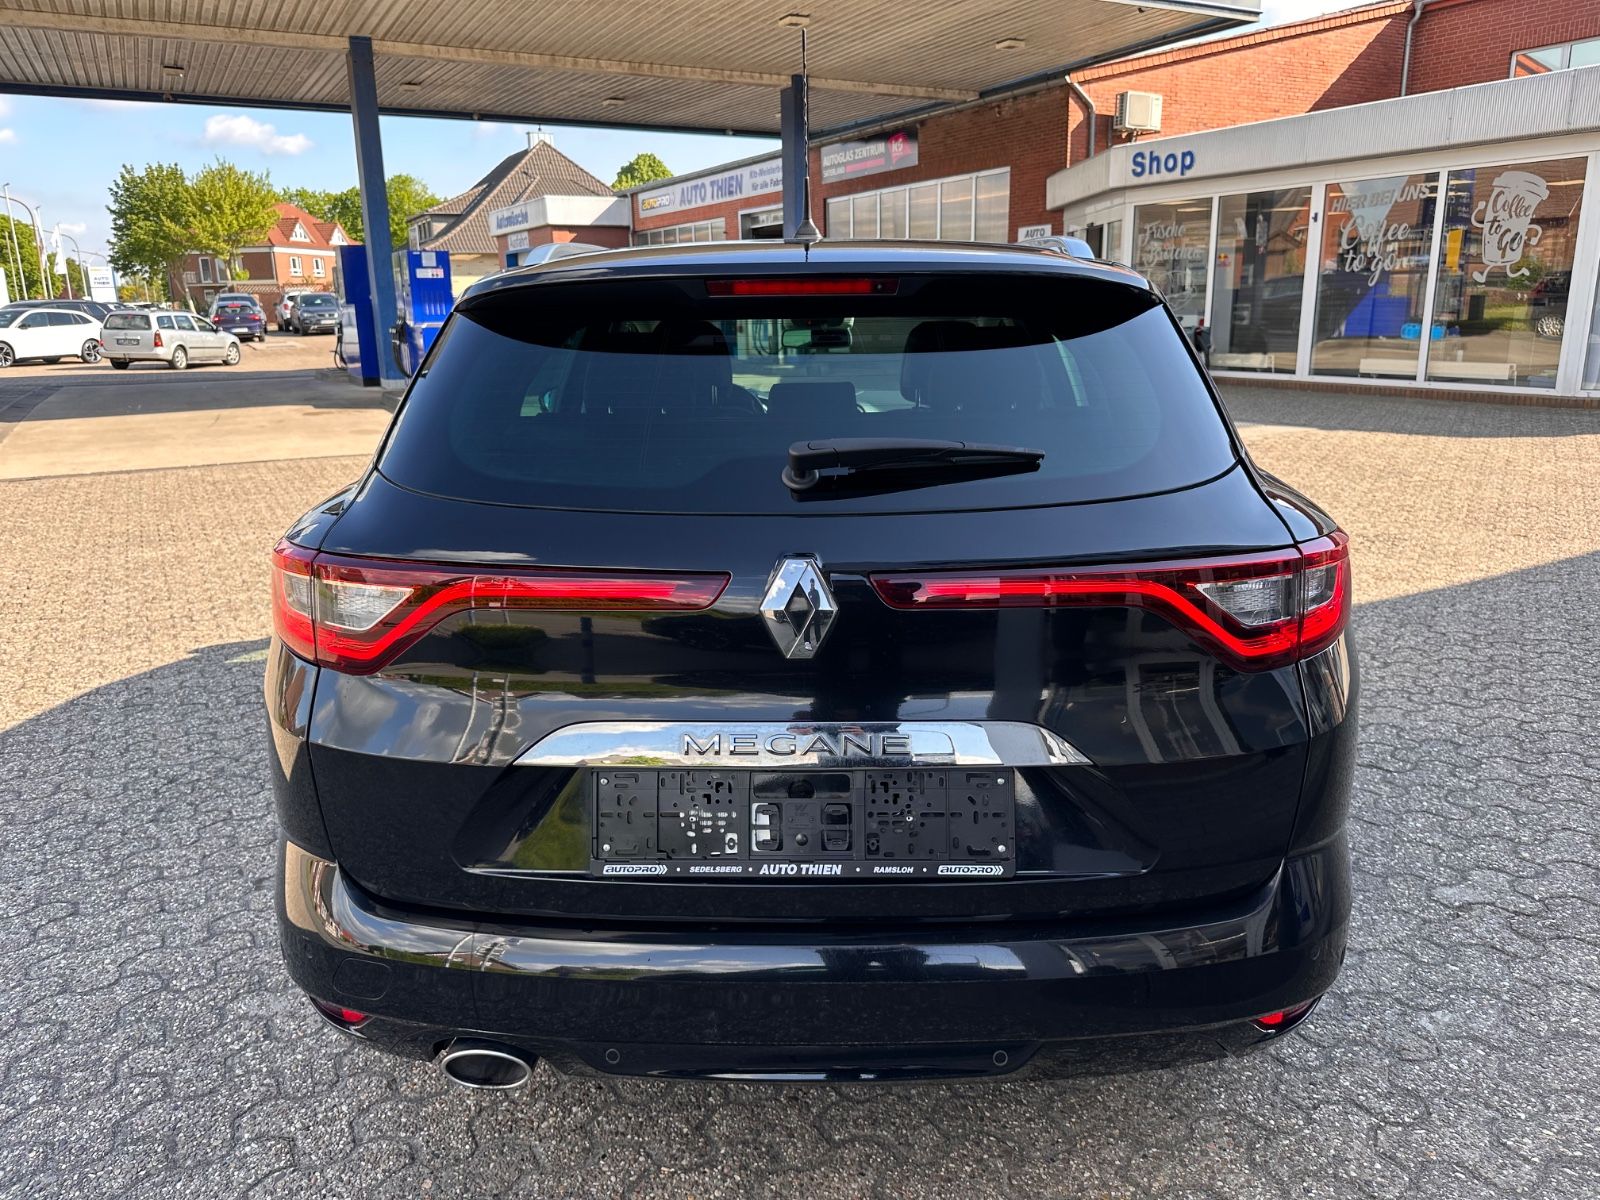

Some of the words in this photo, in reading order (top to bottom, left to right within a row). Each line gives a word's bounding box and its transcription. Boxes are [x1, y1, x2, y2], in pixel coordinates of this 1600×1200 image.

[822, 149, 854, 168] AUTOGLAS
[854, 142, 886, 160] ZENTRUM
[1131, 150, 1195, 177] Shop
[679, 183, 706, 207] AUTO
[709, 173, 744, 201] THIEN
[1331, 194, 1367, 212] HIER
[1368, 189, 1396, 206] BEI
[1397, 184, 1432, 203] UNS
[1491, 189, 1532, 219] Coffee
[1024, 228, 1046, 239] AUTO
[1142, 221, 1187, 244] Frische
[1340, 214, 1410, 258] Coffee
[1486, 216, 1503, 236] to
[1344, 249, 1367, 273] to
[1367, 252, 1397, 287] go
[682, 733, 913, 757] MEGANE
[759, 864, 798, 875] AUTO
[800, 864, 842, 875] THIEN
[873, 866, 914, 874] RAMSLOH
